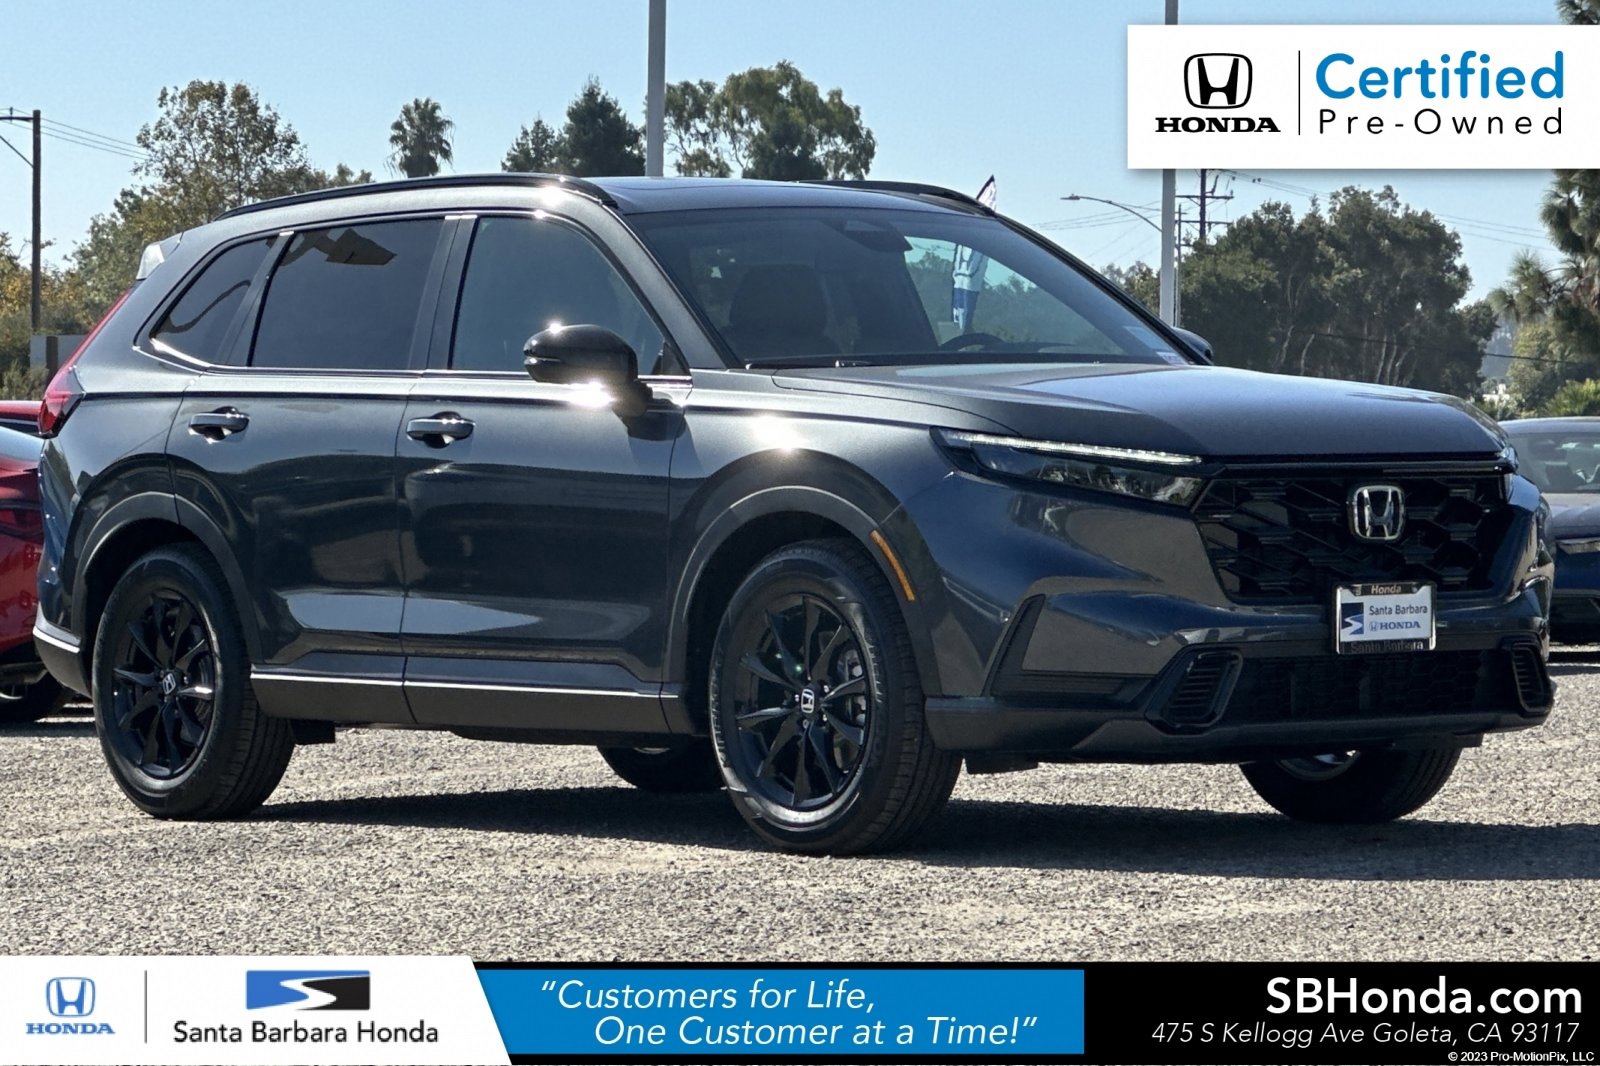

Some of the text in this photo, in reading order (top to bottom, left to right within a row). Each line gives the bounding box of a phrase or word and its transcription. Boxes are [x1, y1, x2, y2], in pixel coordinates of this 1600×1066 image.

[1371, 584, 1402, 595] Honda
[1369, 604, 1428, 616] Santa Barbara
[1380, 621, 1421, 630] HONDA
